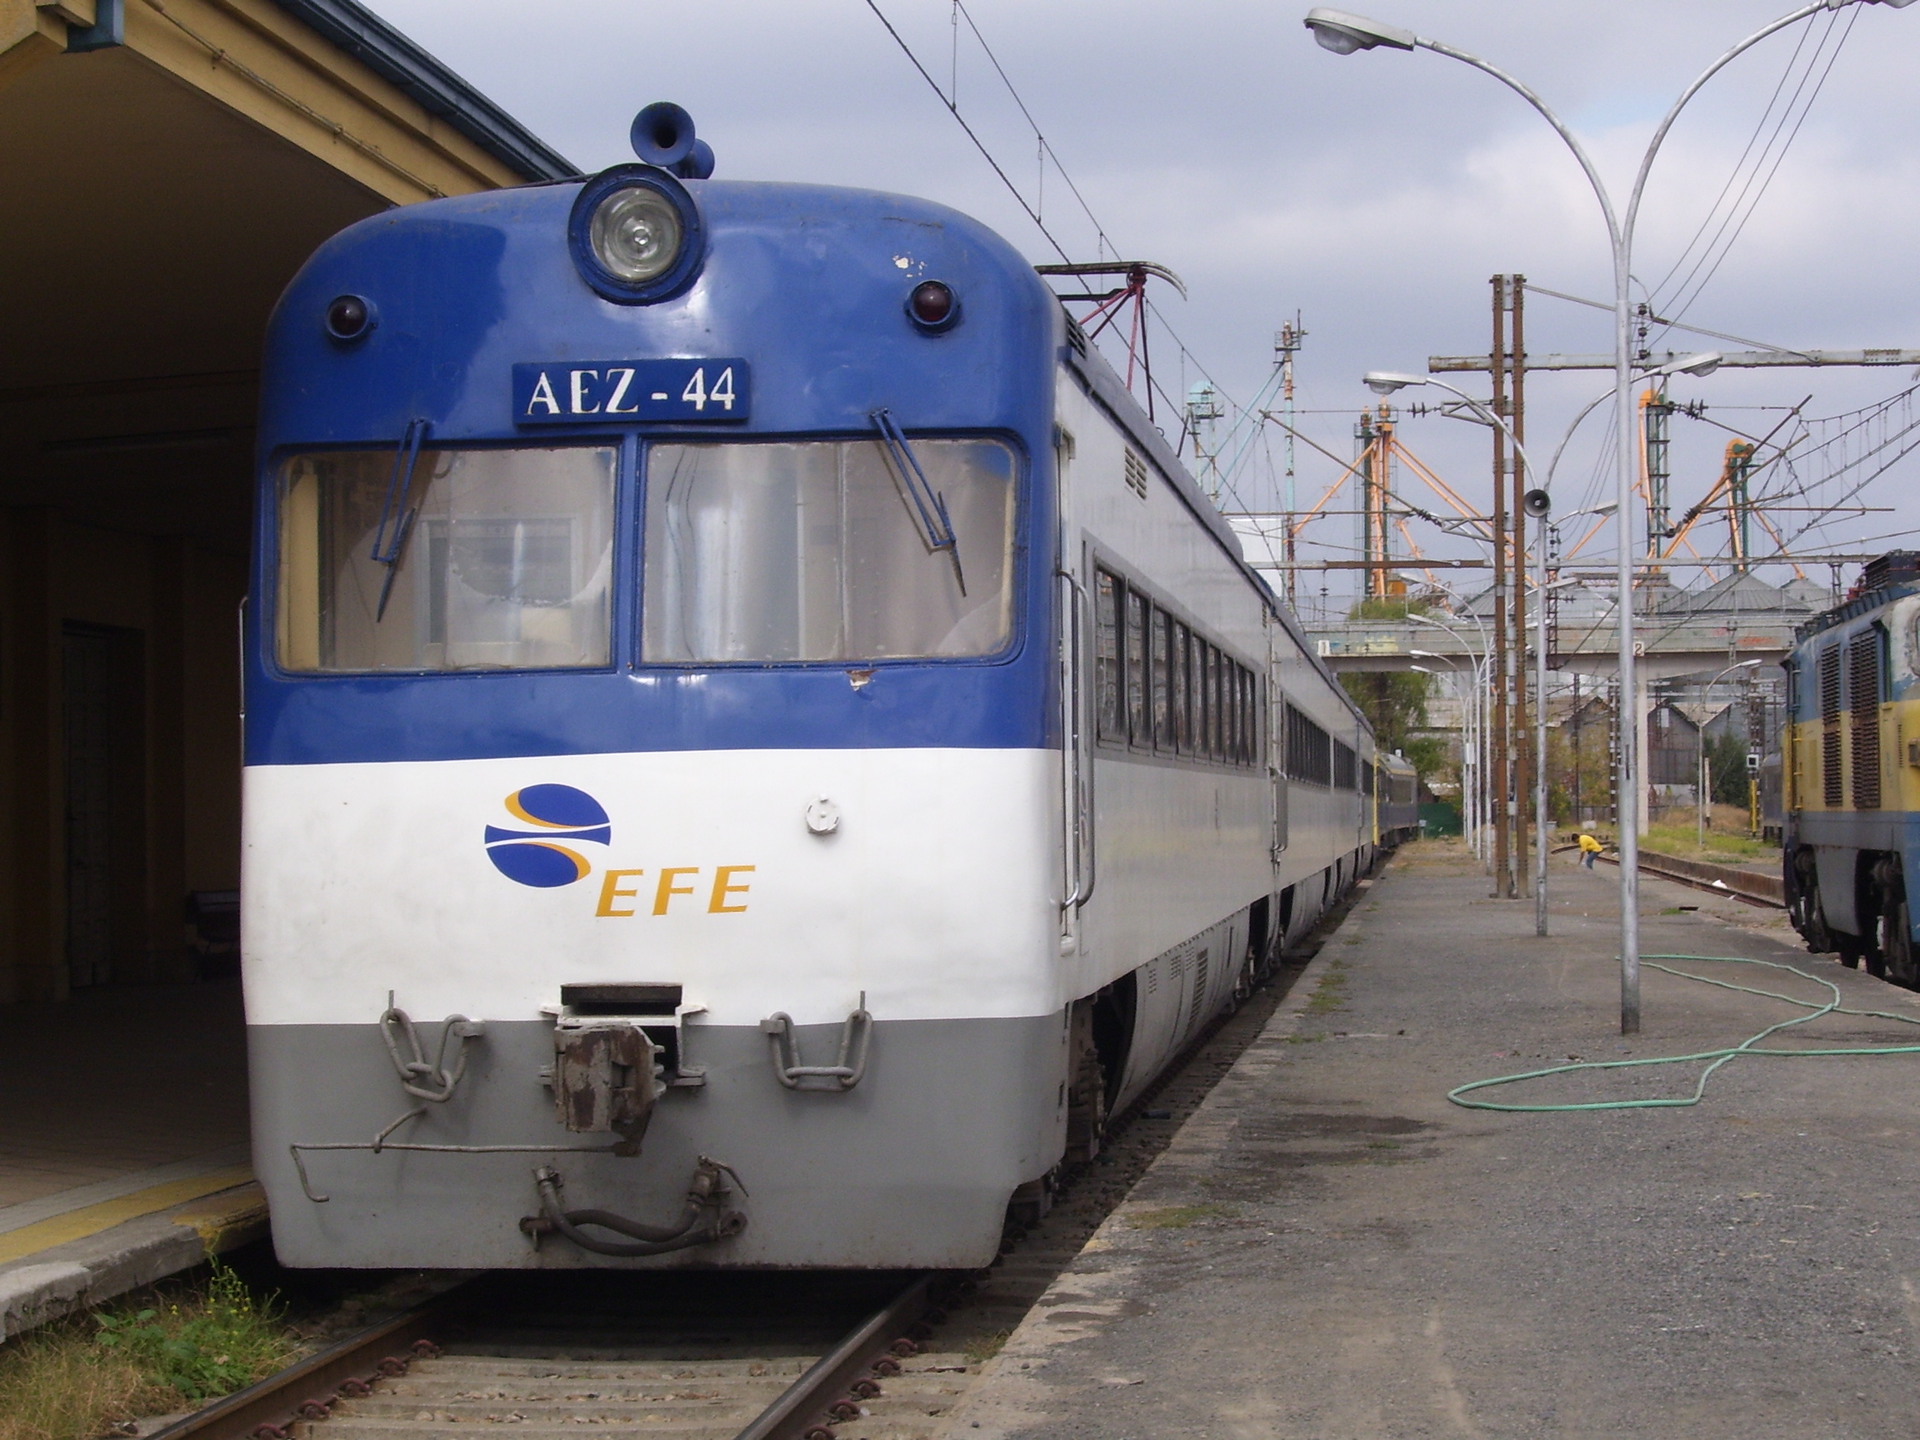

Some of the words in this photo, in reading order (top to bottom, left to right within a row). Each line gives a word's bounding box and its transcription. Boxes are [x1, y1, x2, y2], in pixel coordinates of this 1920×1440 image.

[525, 368, 639, 415] AEZ
[681, 367, 736, 411] 44
[595, 865, 756, 917] EFE
